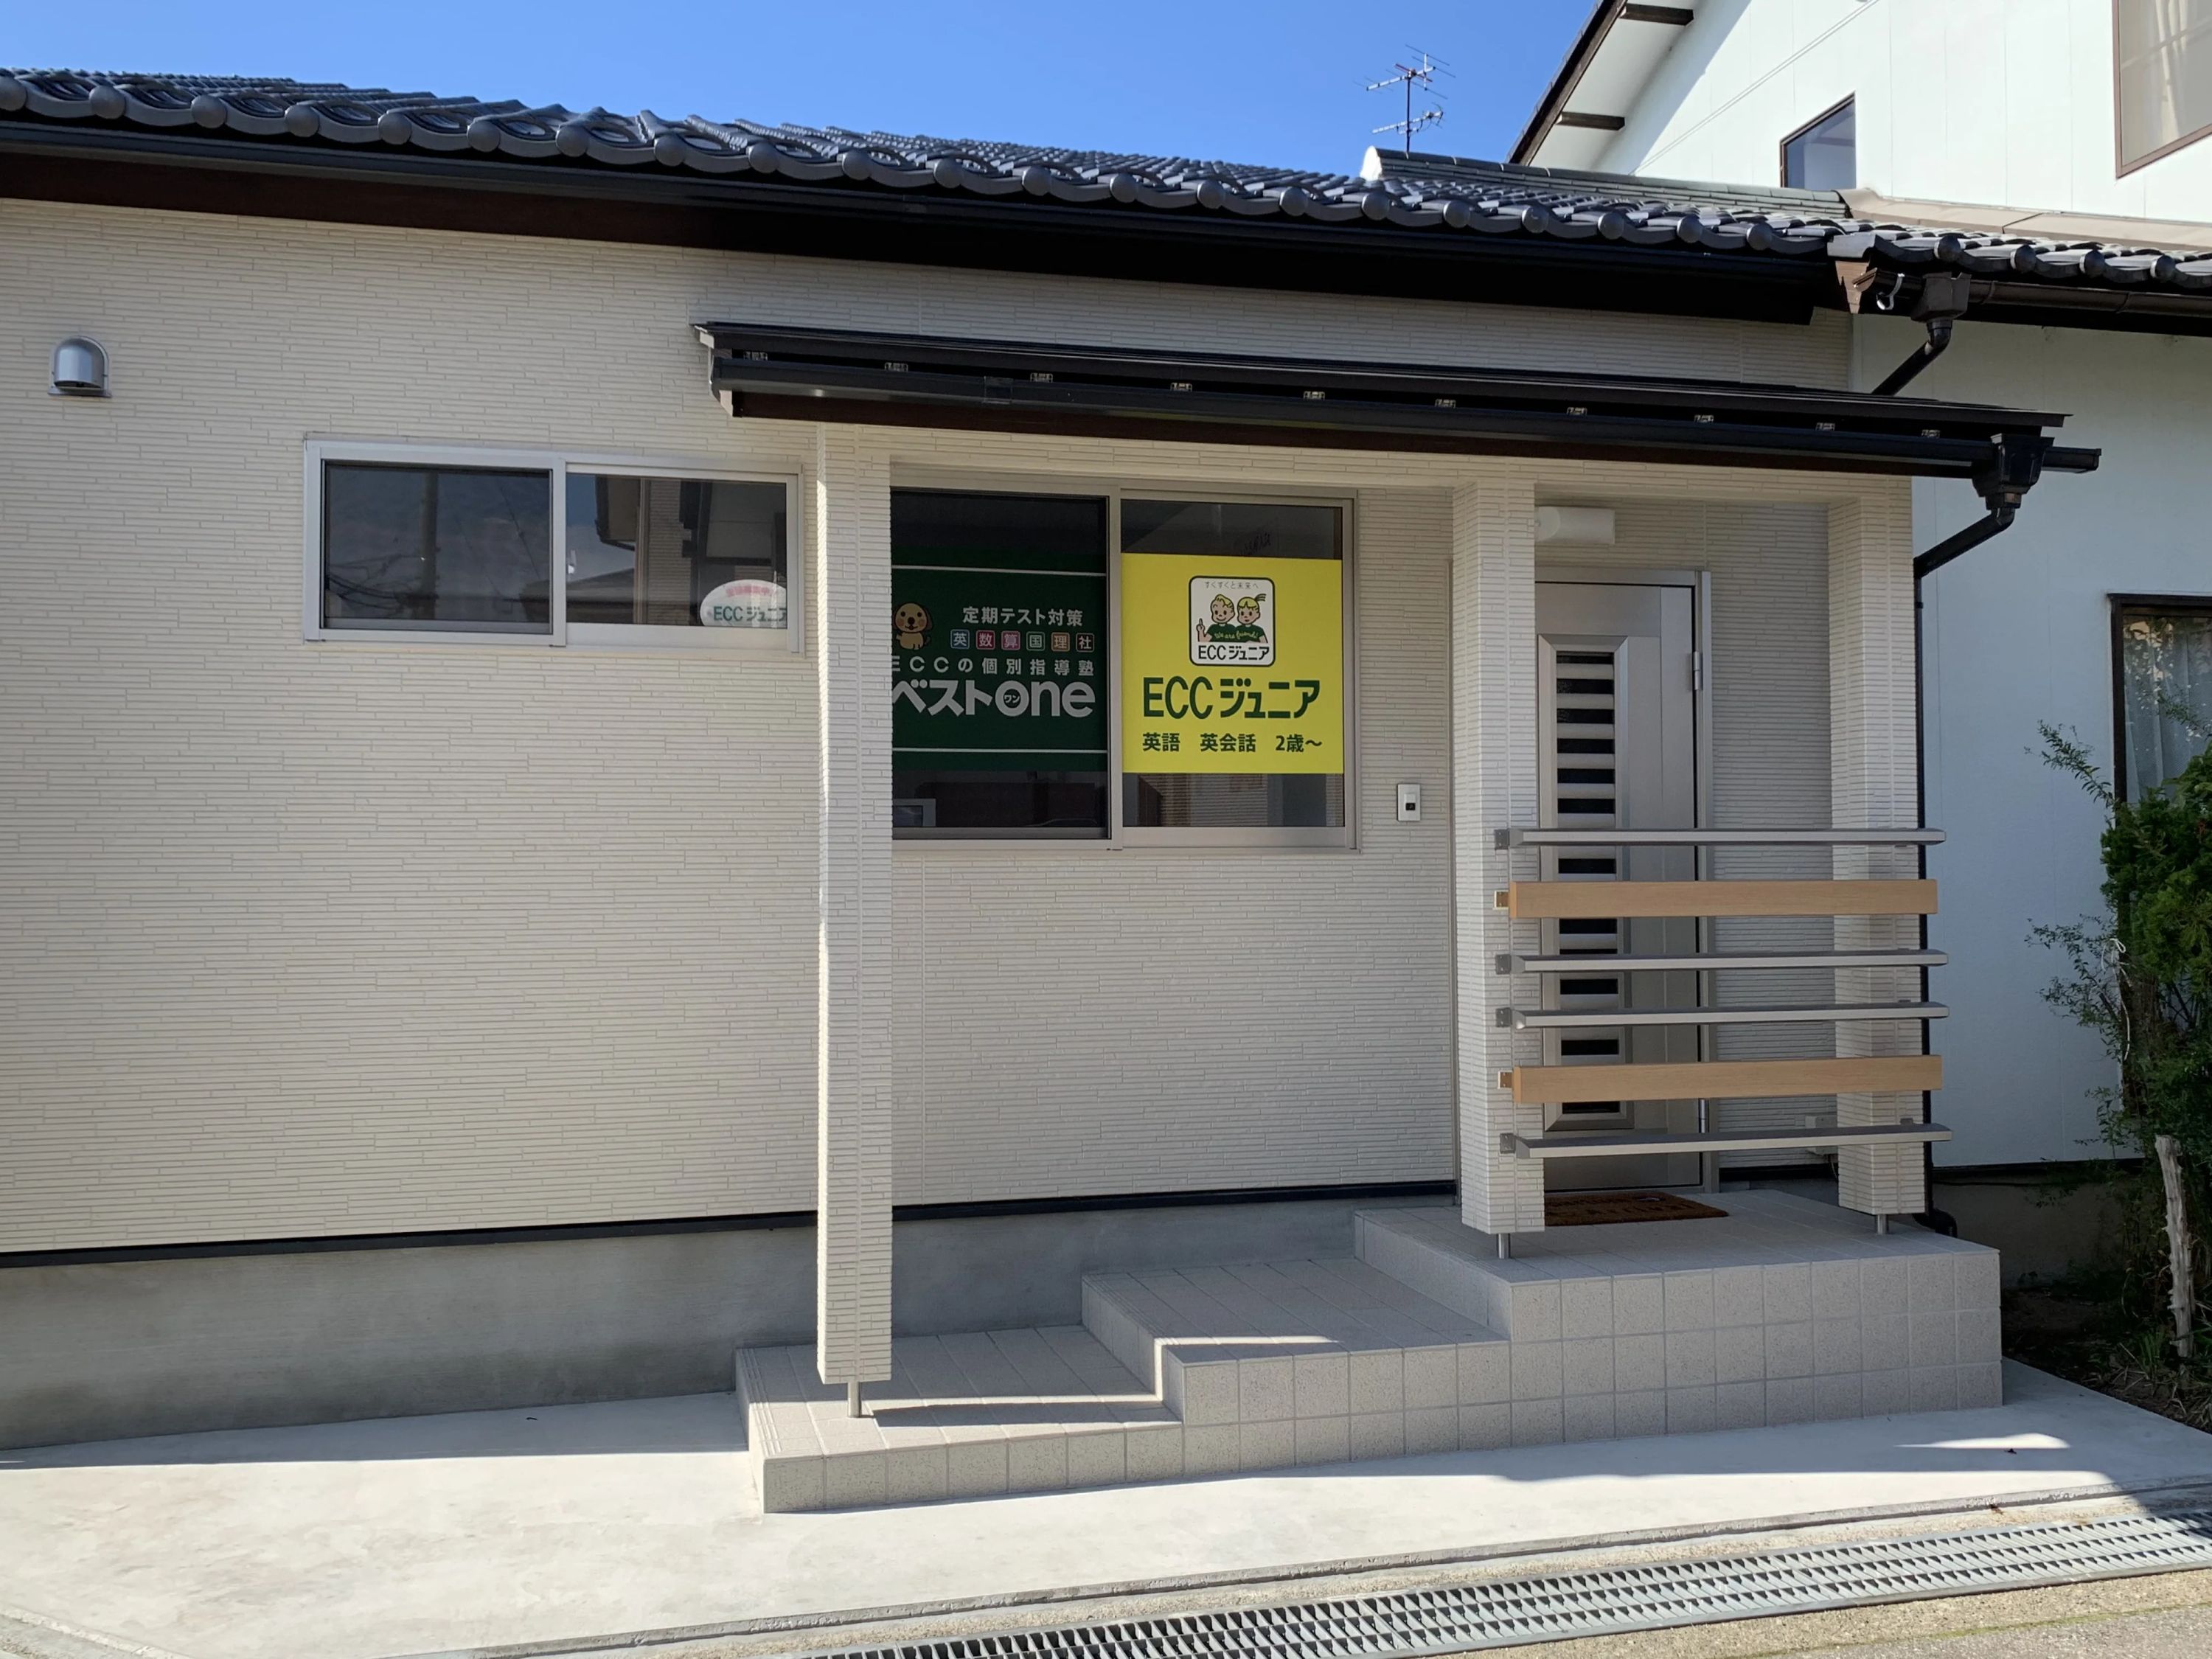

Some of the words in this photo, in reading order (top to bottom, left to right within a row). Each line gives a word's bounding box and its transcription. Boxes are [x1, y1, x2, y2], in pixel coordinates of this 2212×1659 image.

[963, 606, 1083, 627] 定期テスト対策
[1198, 644, 1270, 661] ECCジュニア
[1004, 694, 1021, 703] ワン
[1143, 675, 1321, 720] ECCジュニア
[1142, 732, 1180, 752] 英語
[1200, 732, 1256, 752] 英会話
